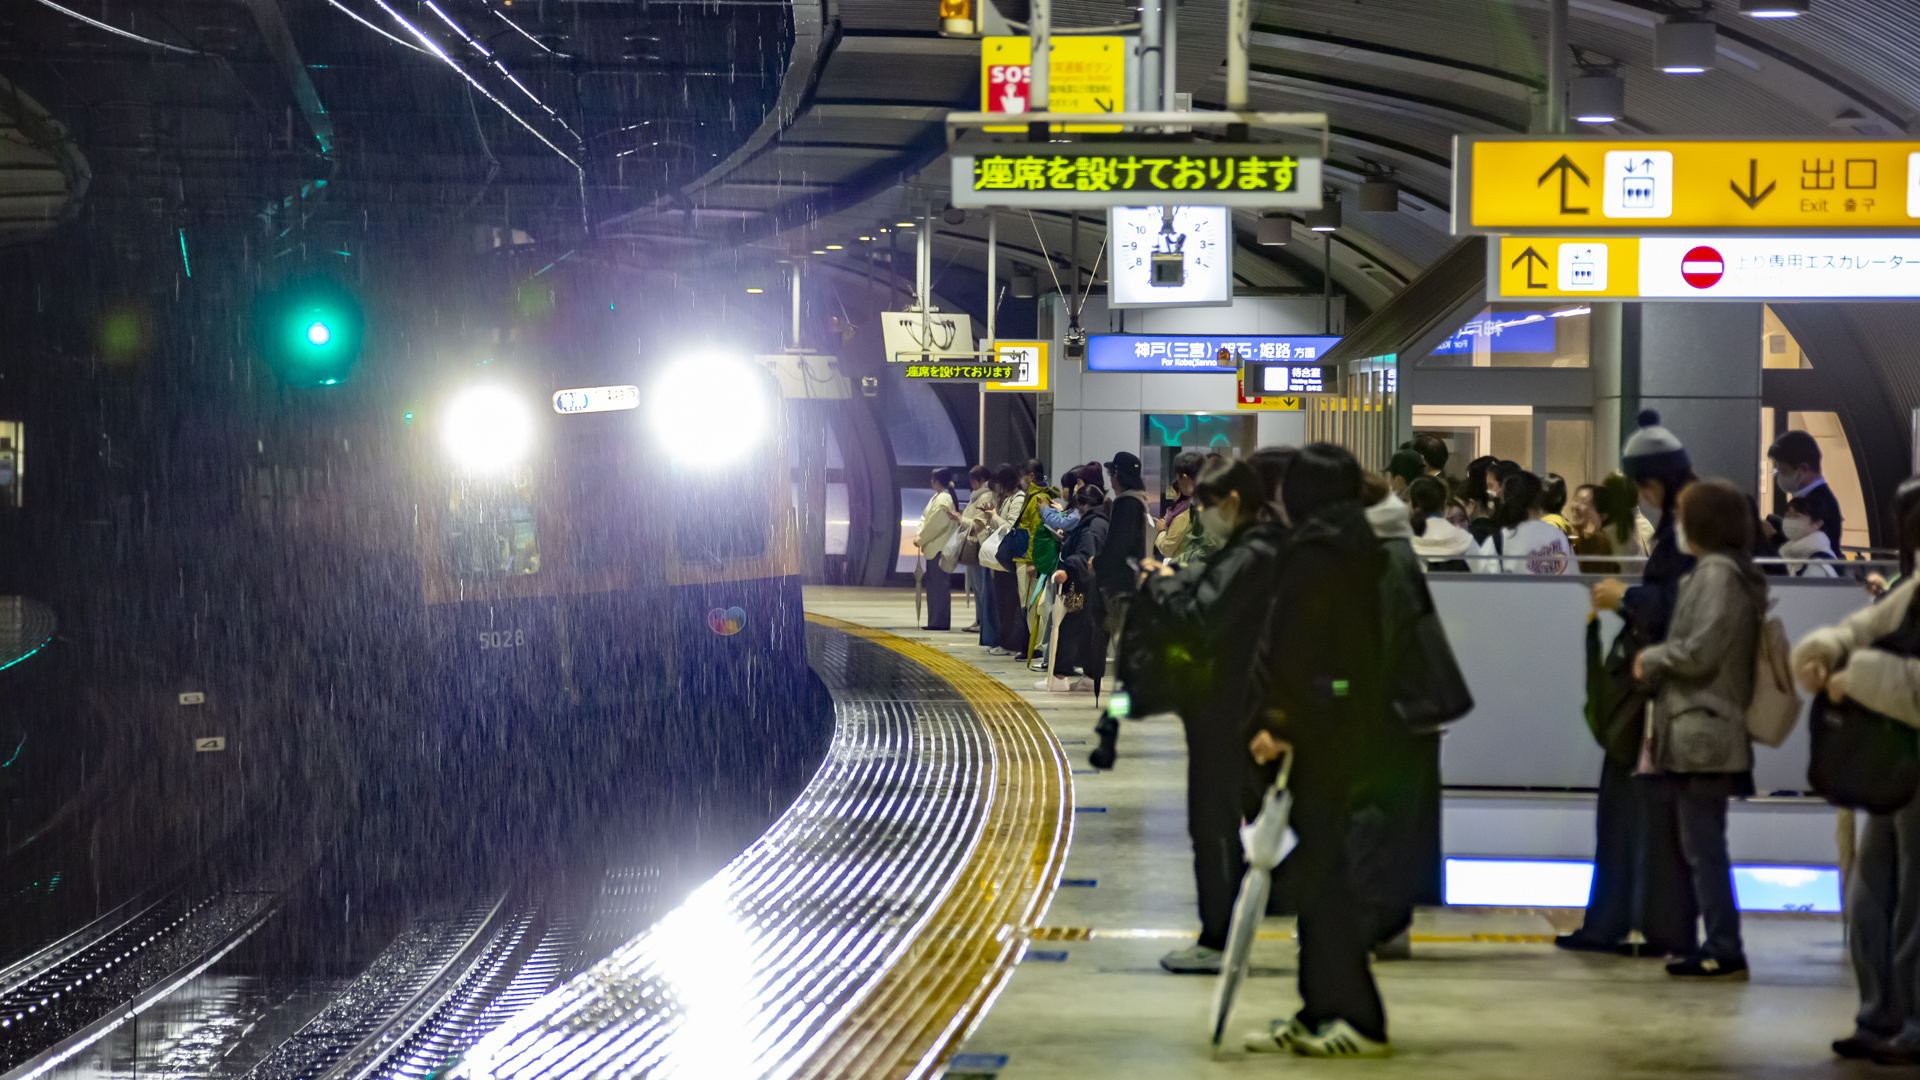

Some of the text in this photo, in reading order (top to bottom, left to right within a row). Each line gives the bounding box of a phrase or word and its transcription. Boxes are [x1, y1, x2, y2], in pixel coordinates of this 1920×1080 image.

[974, 155, 1298, 191] 座席を設けております
[1801, 158, 1877, 190] 出口
[1800, 198, 1829, 213] Exit
[1135, 226, 1147, 235] 10
[1194, 223, 1201, 232] 2
[1130, 241, 1138, 251] 9
[1199, 240, 1206, 250] 3
[1135, 257, 1143, 266] 8
[1194, 257, 1201, 266] 4
[1293, 347, 1316, 359] 方面
[1161, 358, 1173, 367] For
[905, 365, 1013, 378] 座席を設けております
[1291, 367, 1321, 378] 待合室
[479, 628, 525, 650] 5028
